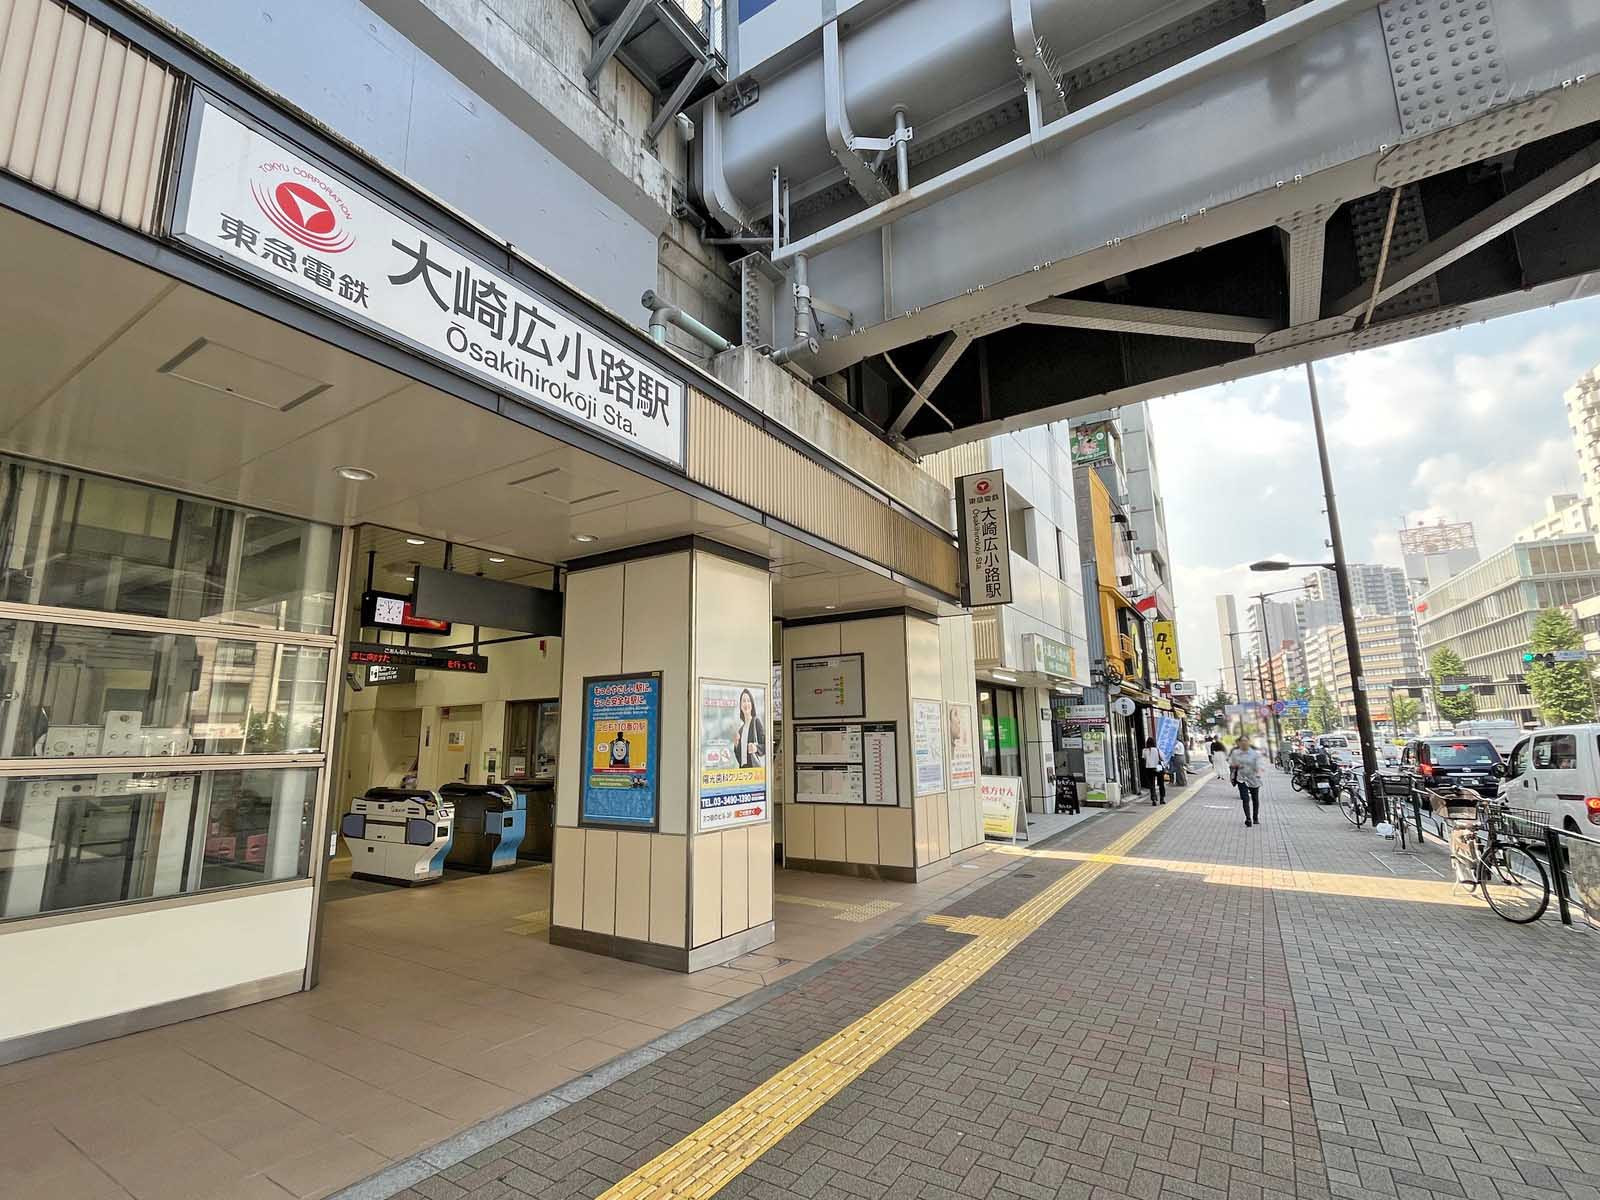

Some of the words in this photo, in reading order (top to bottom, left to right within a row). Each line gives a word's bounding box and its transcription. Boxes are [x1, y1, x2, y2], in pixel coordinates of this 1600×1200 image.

[258, 162, 290, 174] TOKYU
[293, 167, 353, 220] CORPORATION
[218, 212, 370, 309] 東急電鉄
[387, 239, 670, 428] 大崎広小路駅
[446, 320, 597, 419] Ōsakihirokōji
[602, 403, 638, 437] Sta.
[969, 494, 999, 504] 東急電鉄
[981, 506, 1002, 599] 大崎広小路駅
